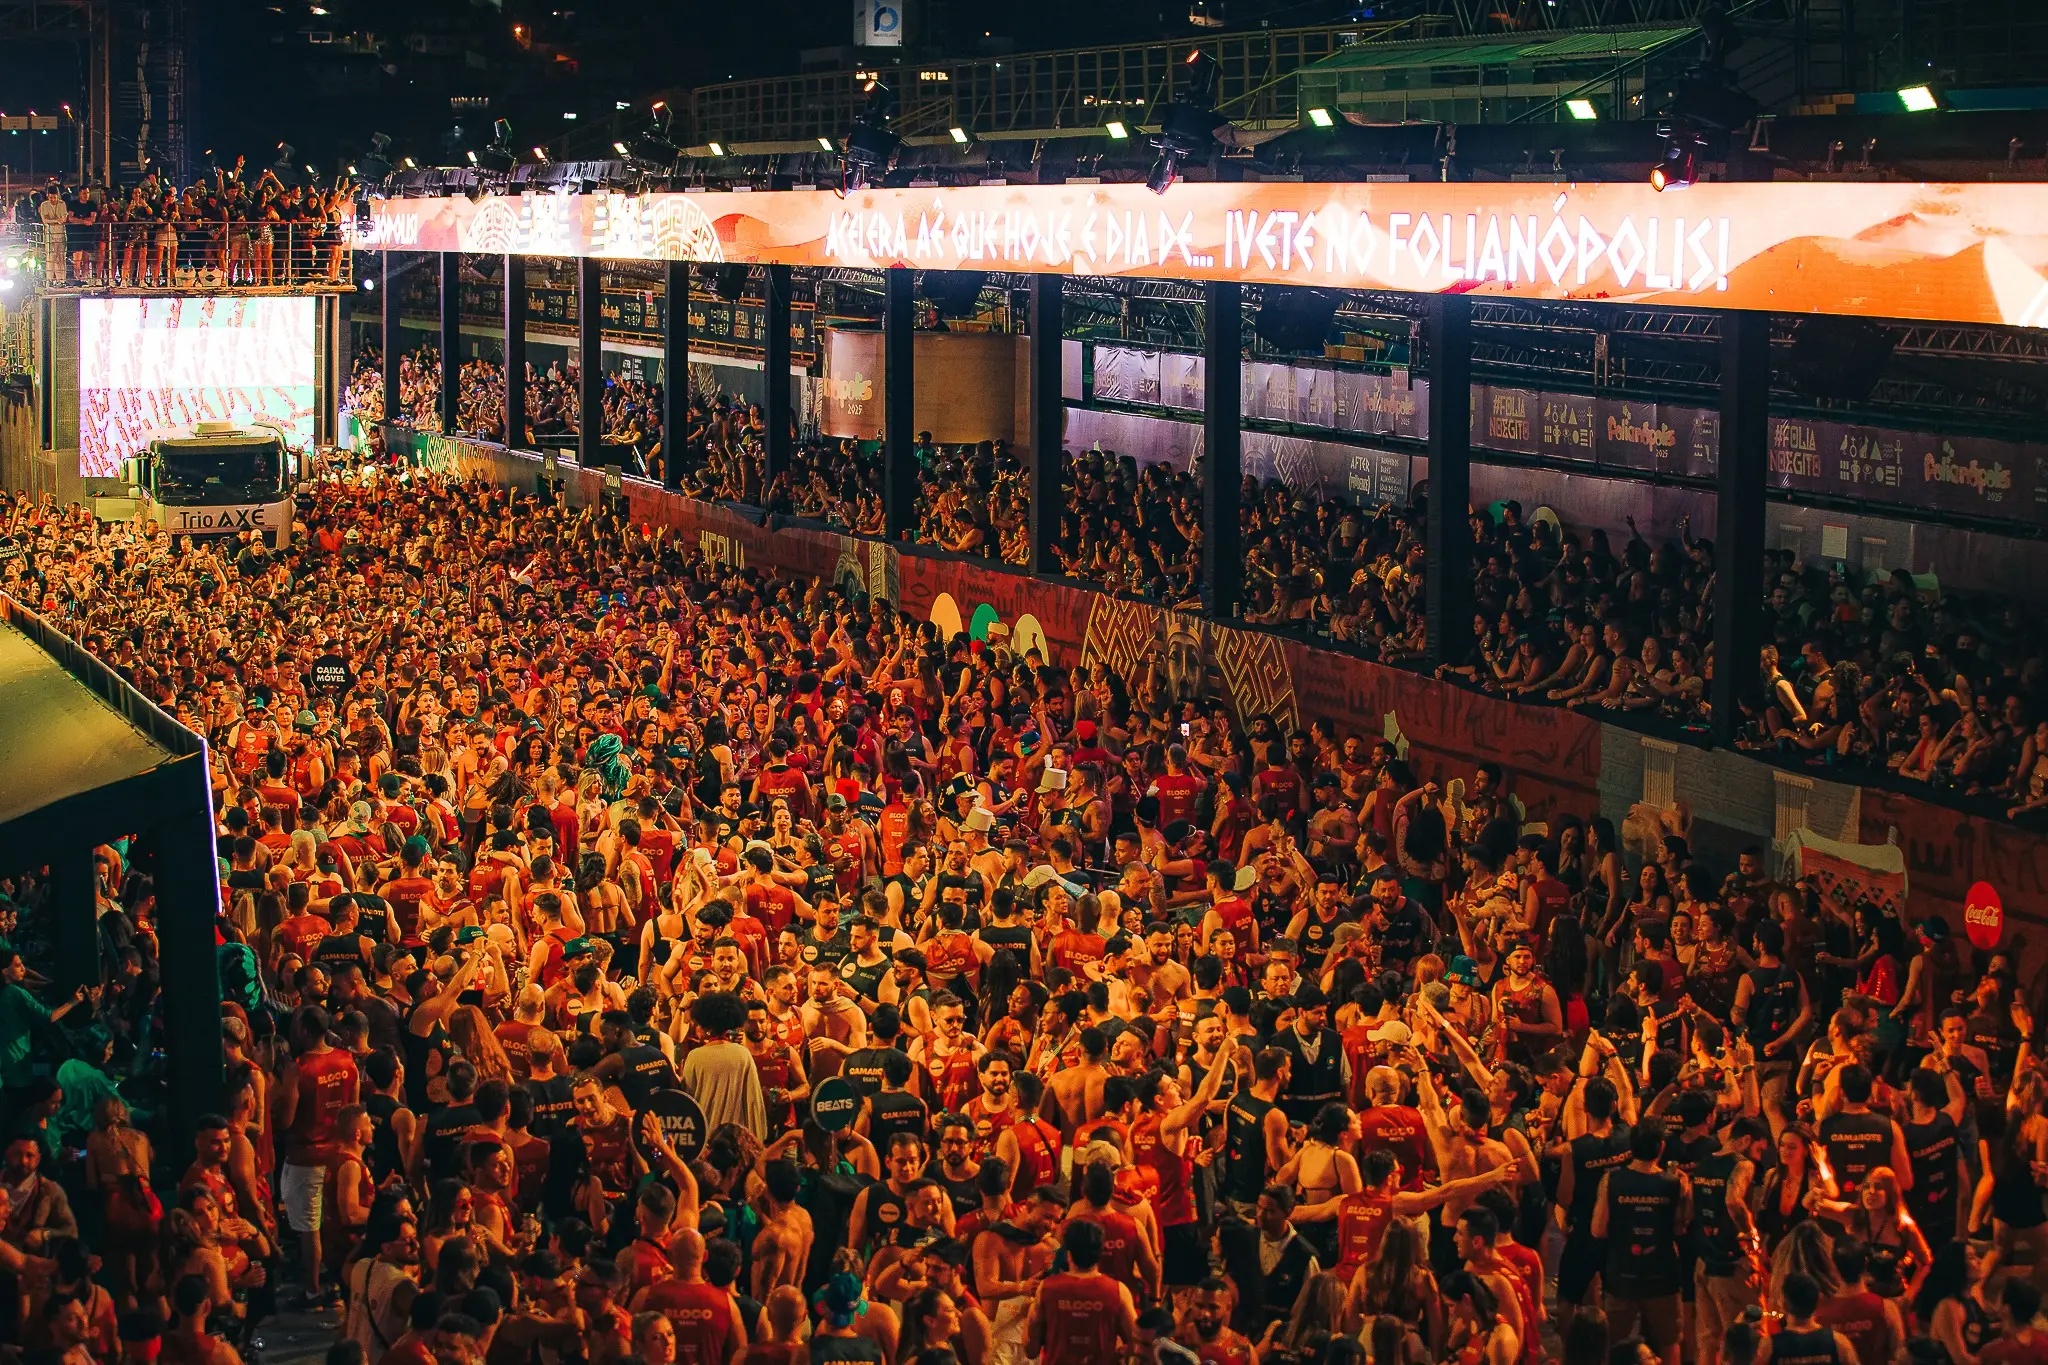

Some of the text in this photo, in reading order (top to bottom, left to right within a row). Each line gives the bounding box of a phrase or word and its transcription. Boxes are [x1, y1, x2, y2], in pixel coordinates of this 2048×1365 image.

[825, 193, 1731, 291] ACELERA AÊ QUE HOJE É DIA DE... IVETE NO FOLIANÓPOLIS!
[1493, 395, 1525, 417] #FOLIA
[1490, 417, 1529, 440] NOEGITO
[1774, 425, 1816, 451] #FOLIA
[1655, 449, 1668, 458] 2025
[1350, 456, 1370, 472] AFTER
[1769, 450, 1820, 478] NOEGITO
[180, 505, 266, 529] Trio AXÉ
[317, 666, 345, 675] CAIXA
[317, 673, 346, 682] MÓVEL
[769, 787, 795, 795] BLOCO
[1966, 903, 1998, 927] Coca-Cola
[298, 931, 324, 942] BLOCO
[319, 952, 358, 960] CAMAROTE
[1064, 951, 1095, 962] BLOCO
[318, 1070, 347, 1084] BLOCO
[817, 1098, 853, 1112] BEATS
[881, 1110, 920, 1119] CAMAROTE
[641, 1116, 695, 1129] AIXA
[1377, 1126, 1414, 1136] BLOCO
[1831, 1133, 1882, 1142] CAMAROTE
[1347, 1206, 1382, 1217] BLOCO
[1058, 1300, 1103, 1311] BLOCO
[664, 1309, 711, 1320] BLOCO
